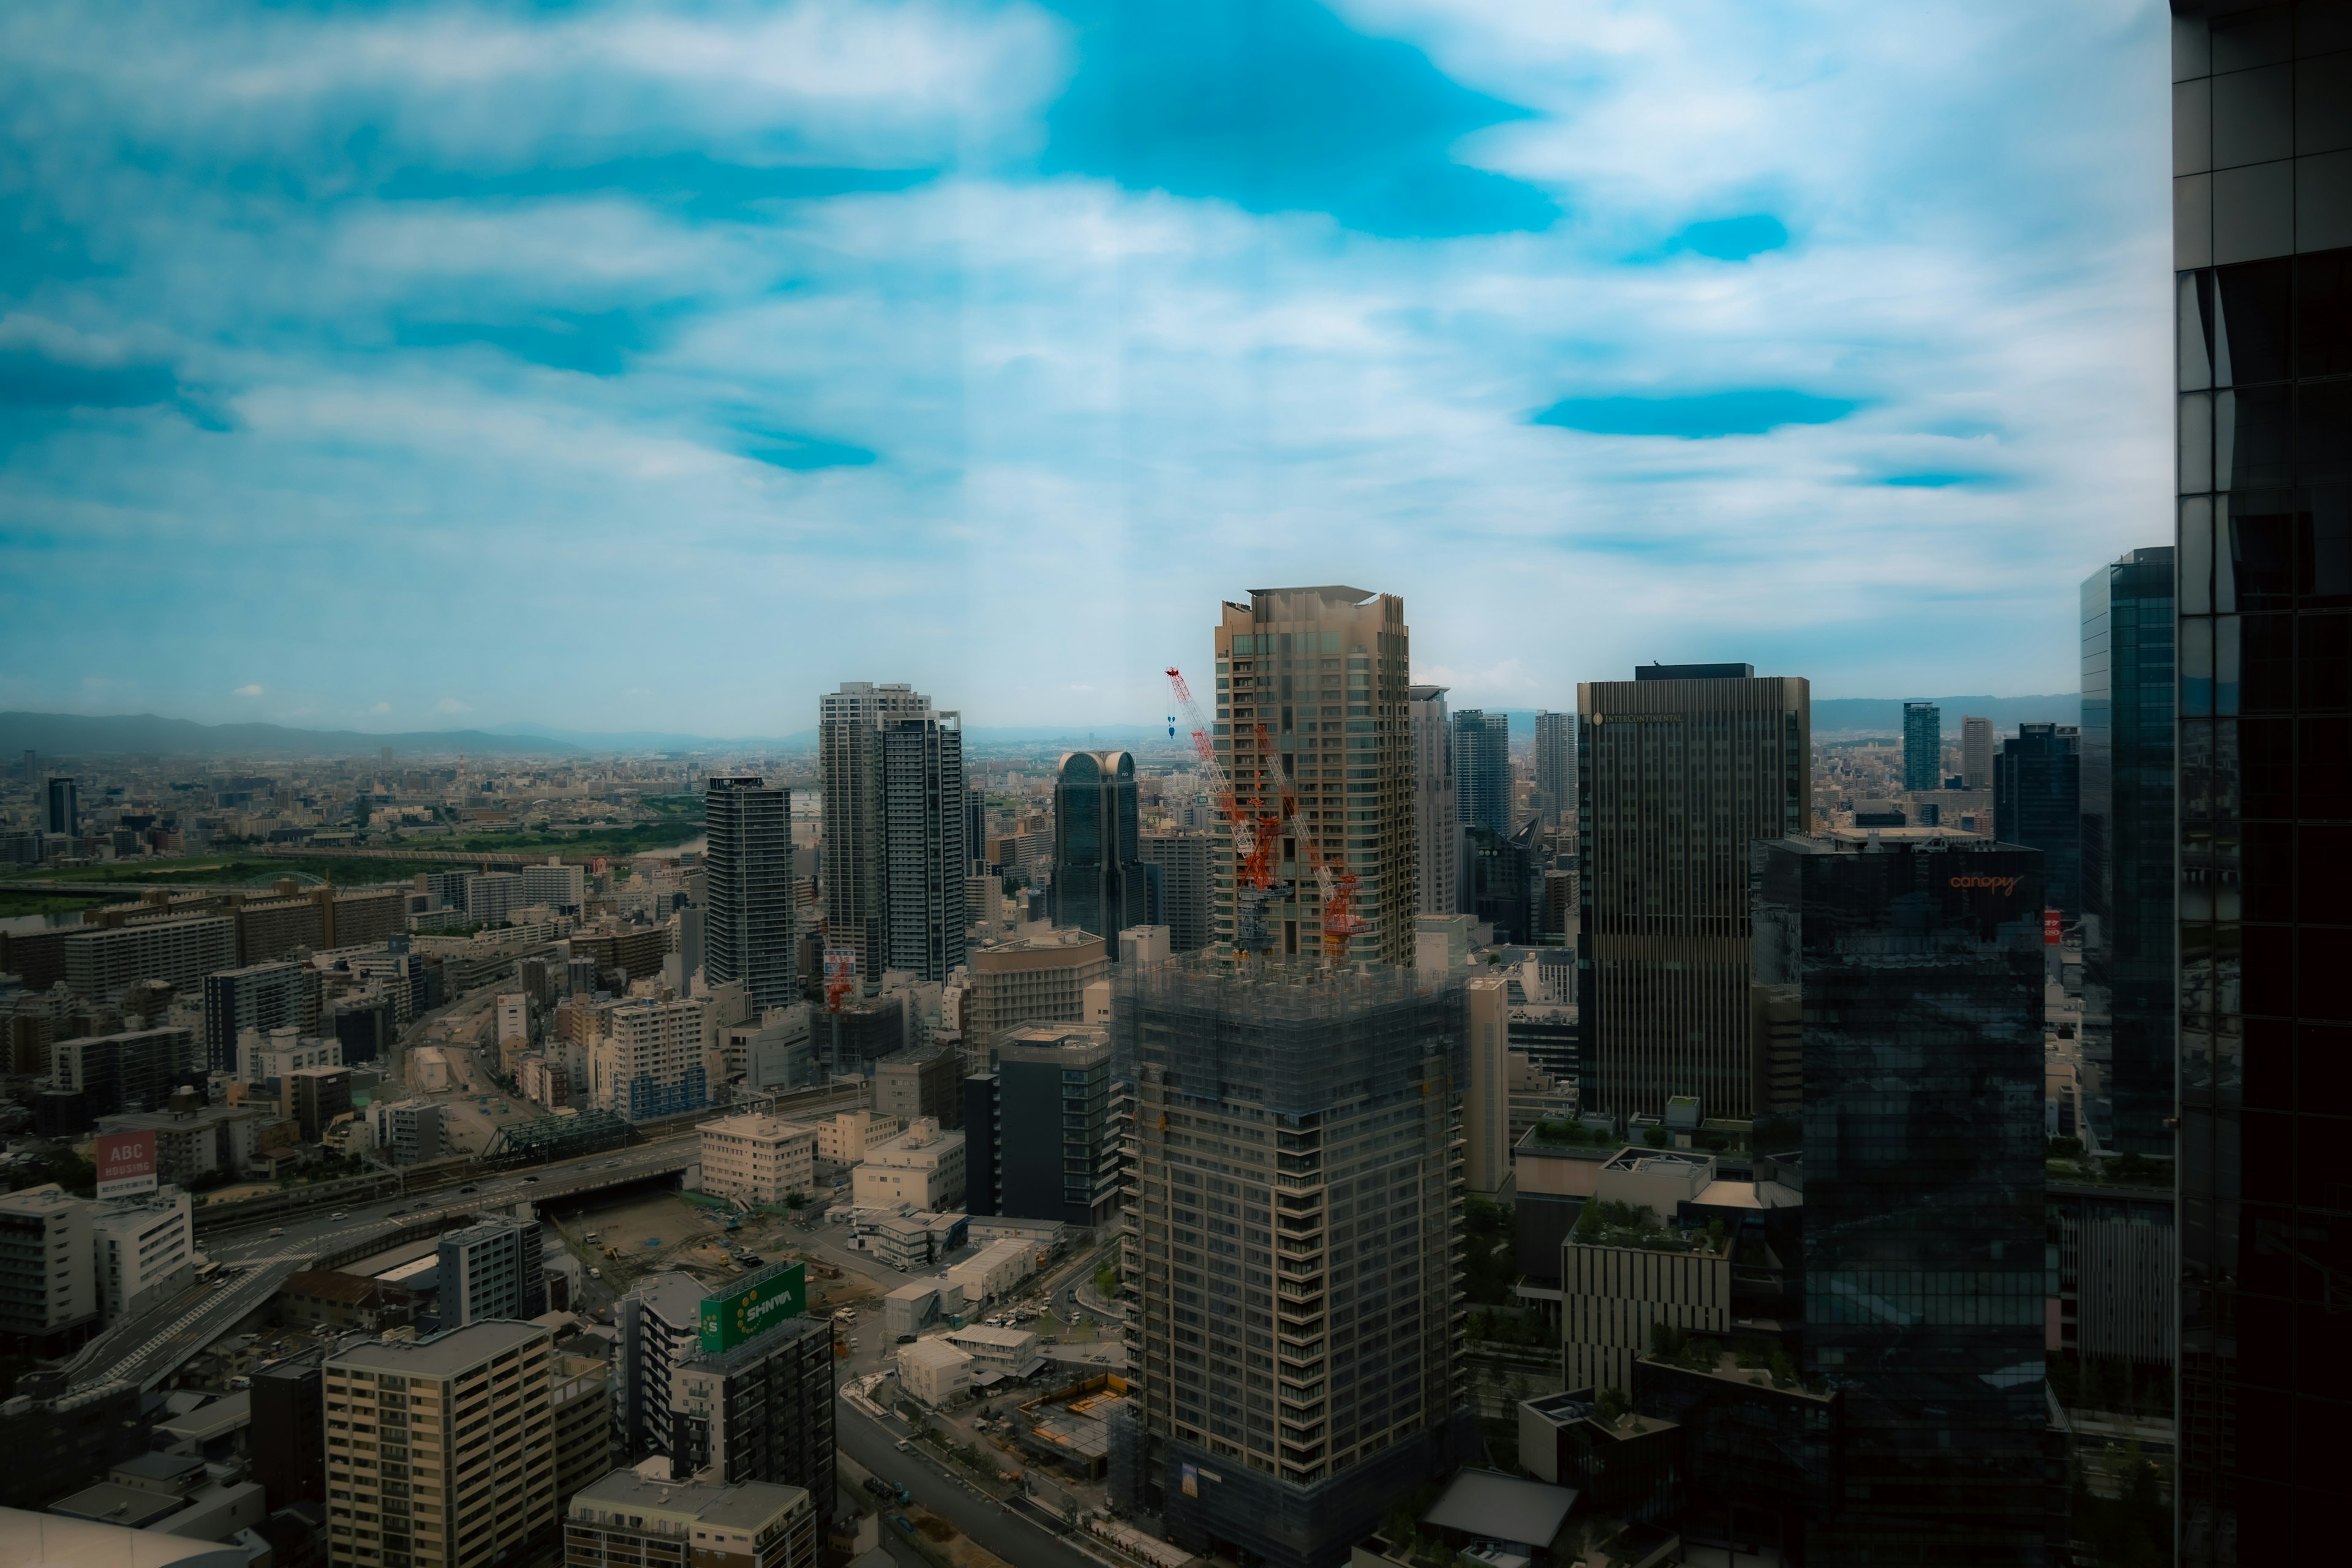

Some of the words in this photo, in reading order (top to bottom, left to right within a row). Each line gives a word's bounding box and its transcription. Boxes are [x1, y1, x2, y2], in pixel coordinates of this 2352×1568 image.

[1950, 875, 2024, 897] canopy
[110, 1144, 143, 1162] ABC
[105, 1162, 150, 1177] HOUSING
[747, 1290, 792, 1322] SHINWA
[709, 1322, 718, 1332] S
